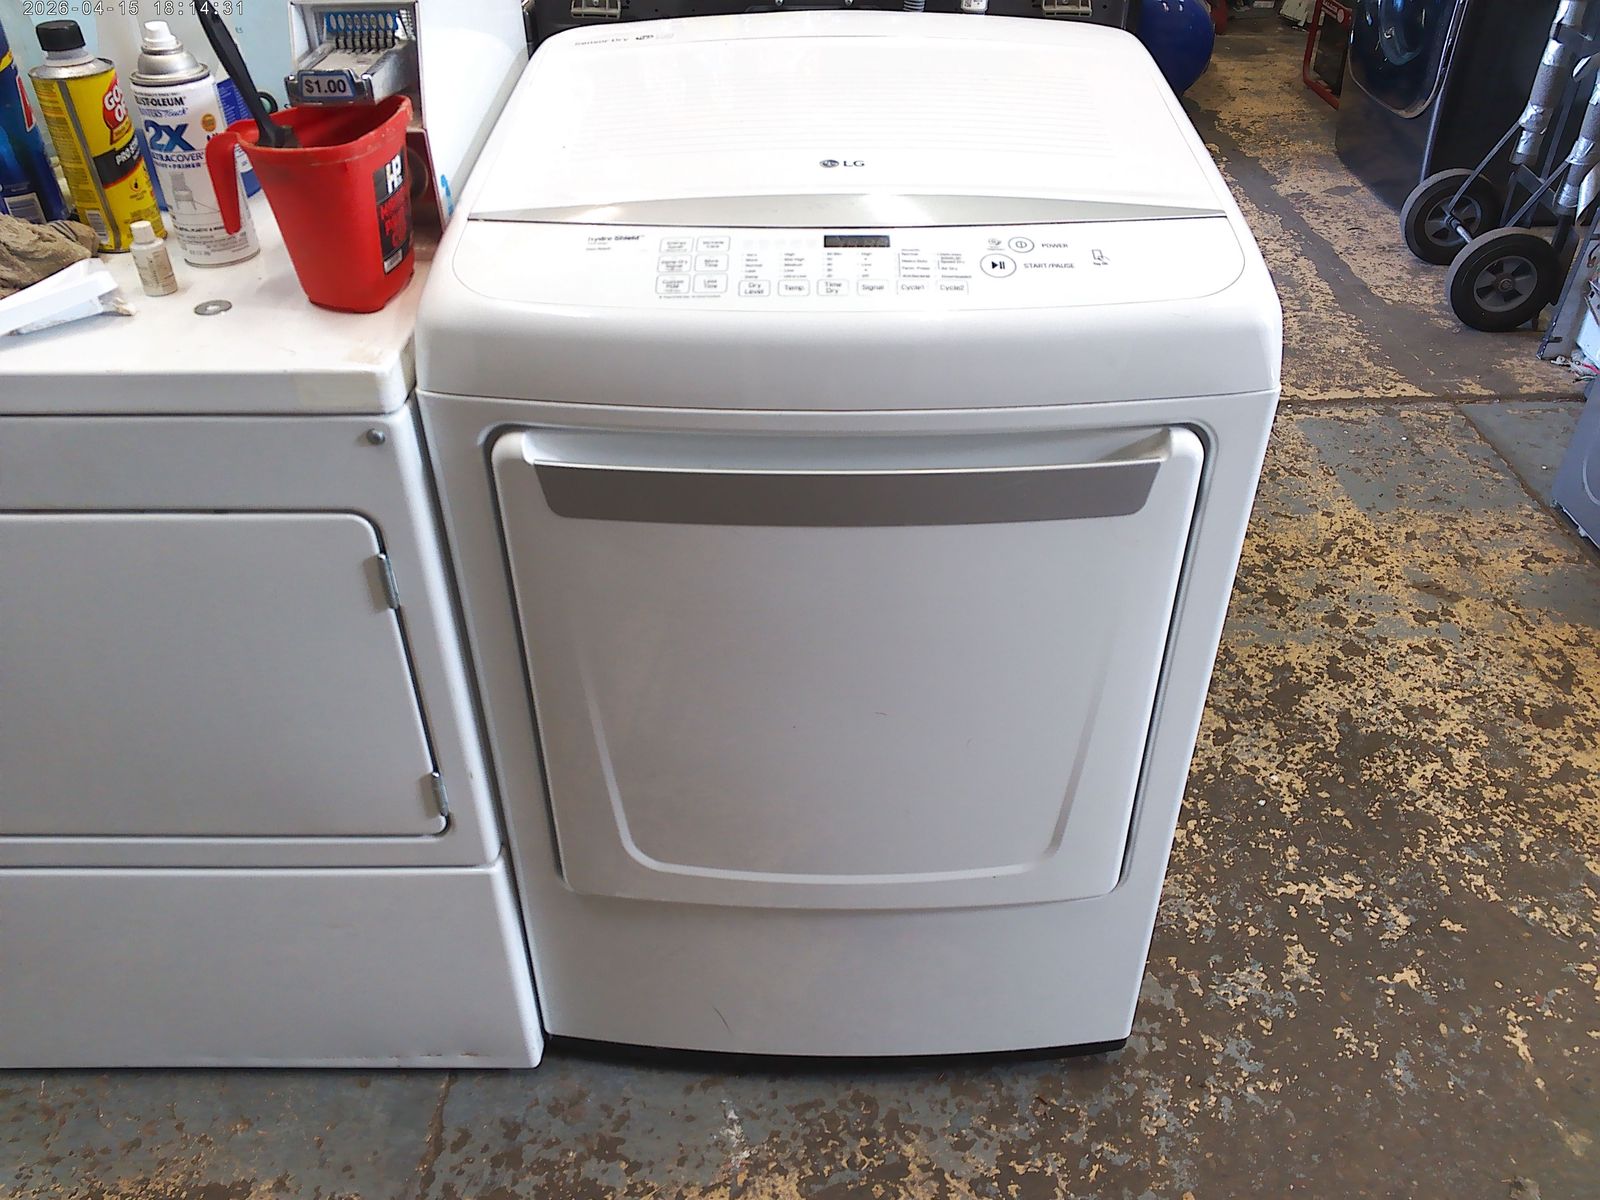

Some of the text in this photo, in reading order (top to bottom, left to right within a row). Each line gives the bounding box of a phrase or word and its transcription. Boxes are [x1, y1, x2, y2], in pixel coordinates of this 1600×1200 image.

[304, 79, 347, 95] $1.00
[144, 119, 196, 152] 2X
[843, 160, 865, 168] LG
[1023, 262, 1075, 270] START/PAUSE
